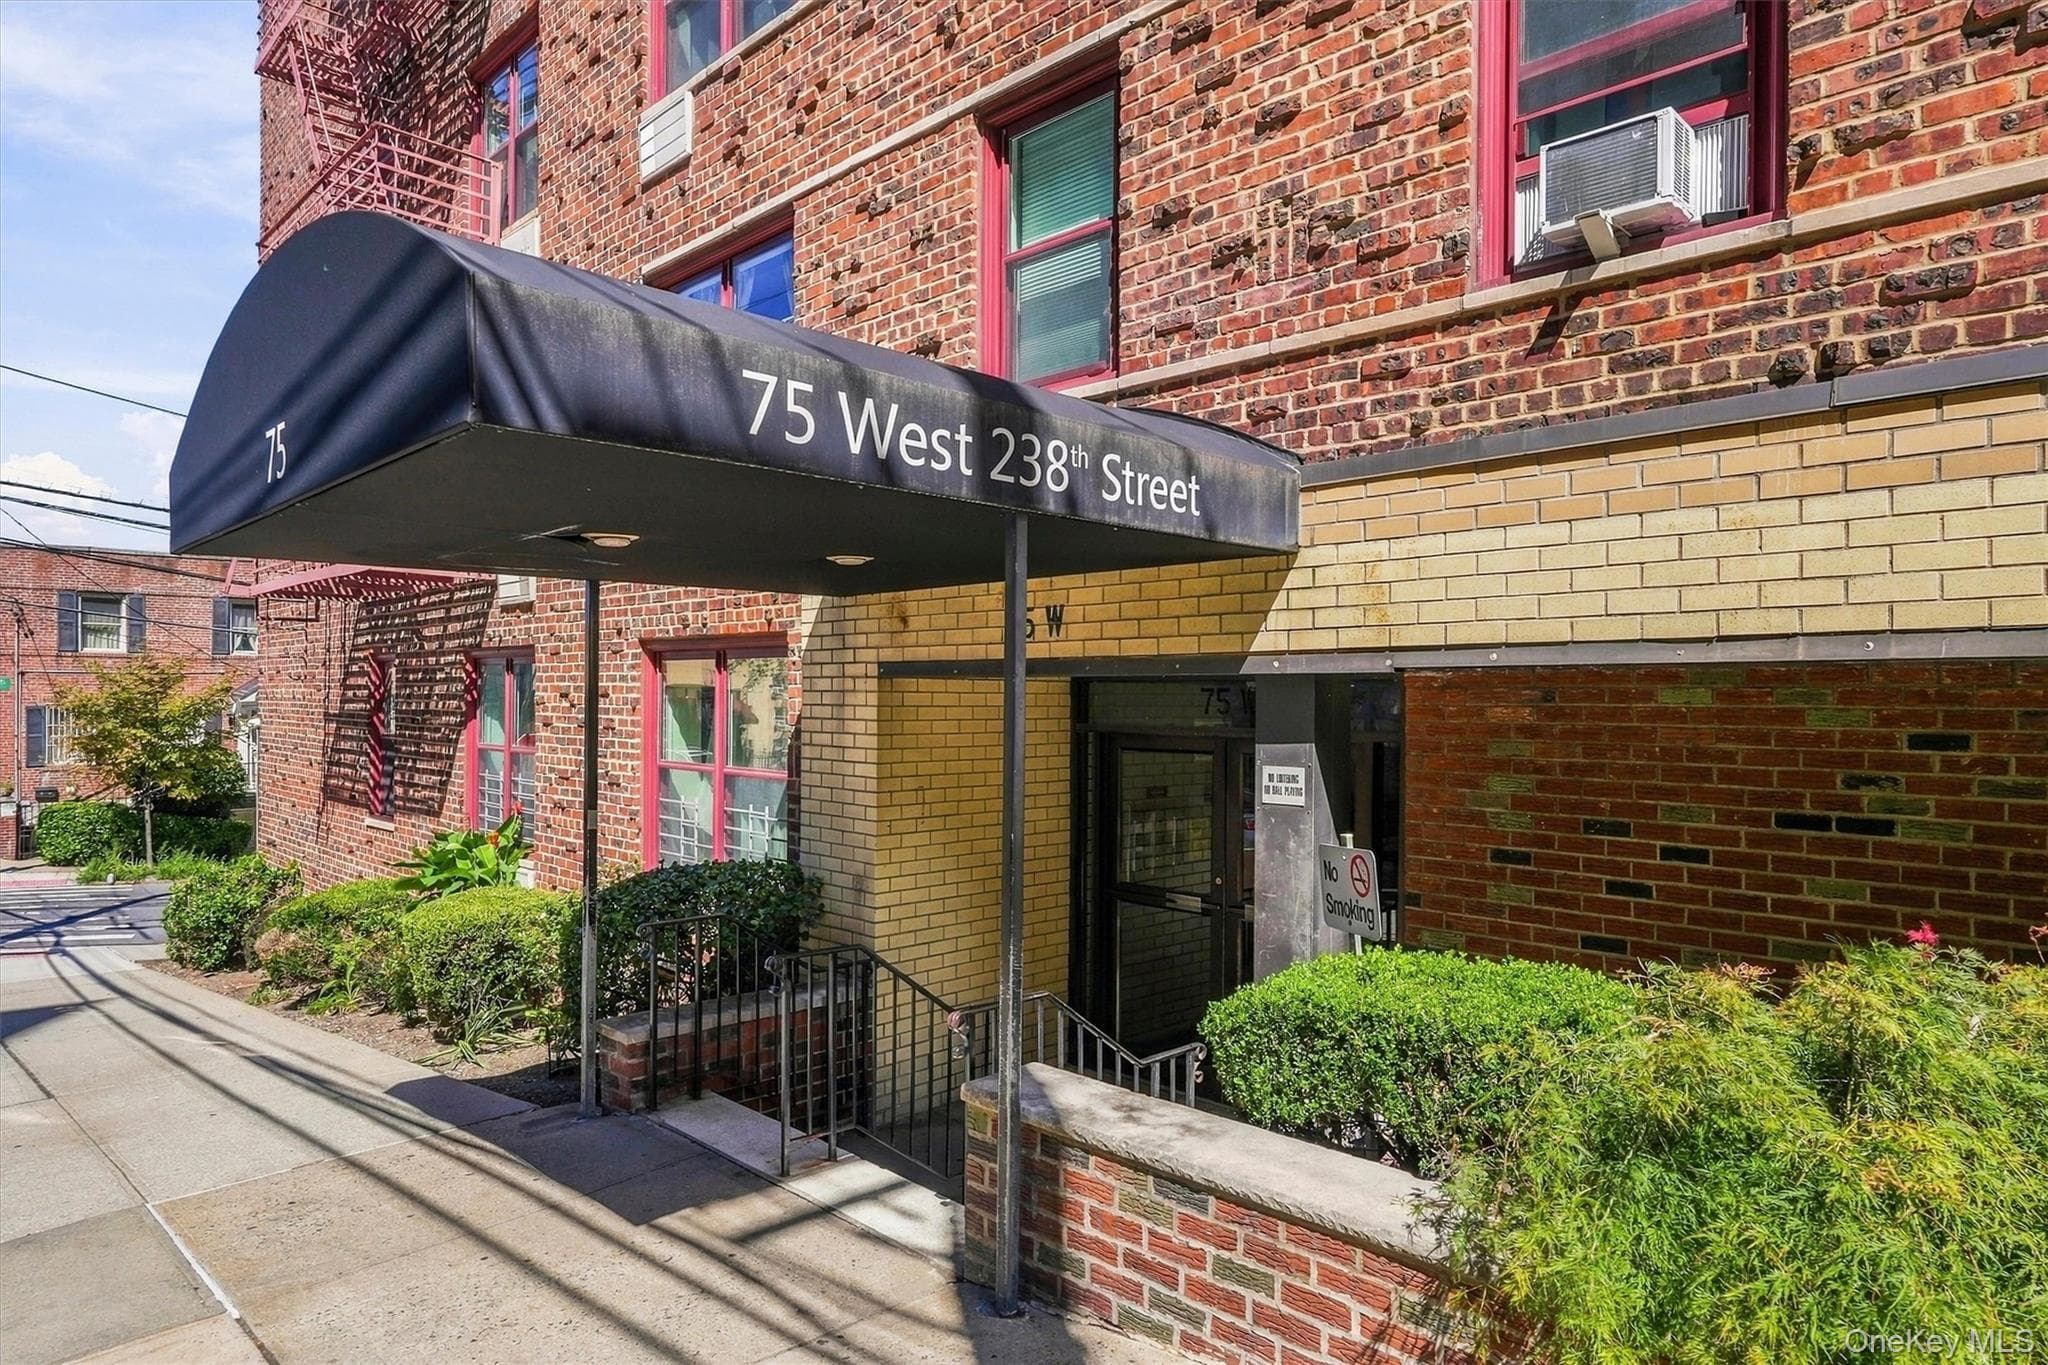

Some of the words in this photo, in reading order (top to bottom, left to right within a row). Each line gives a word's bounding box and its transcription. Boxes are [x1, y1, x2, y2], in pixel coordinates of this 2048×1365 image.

[265, 421, 287, 484] 75
[741, 368, 816, 445] 75
[838, 390, 974, 476] West
[990, 427, 1089, 492] 238th
[1101, 453, 1200, 517] Street
[1045, 604, 1065, 638] W
[1200, 687, 1231, 715] 75
[1323, 859, 1339, 883] No
[1326, 892, 1375, 931] Smoking
